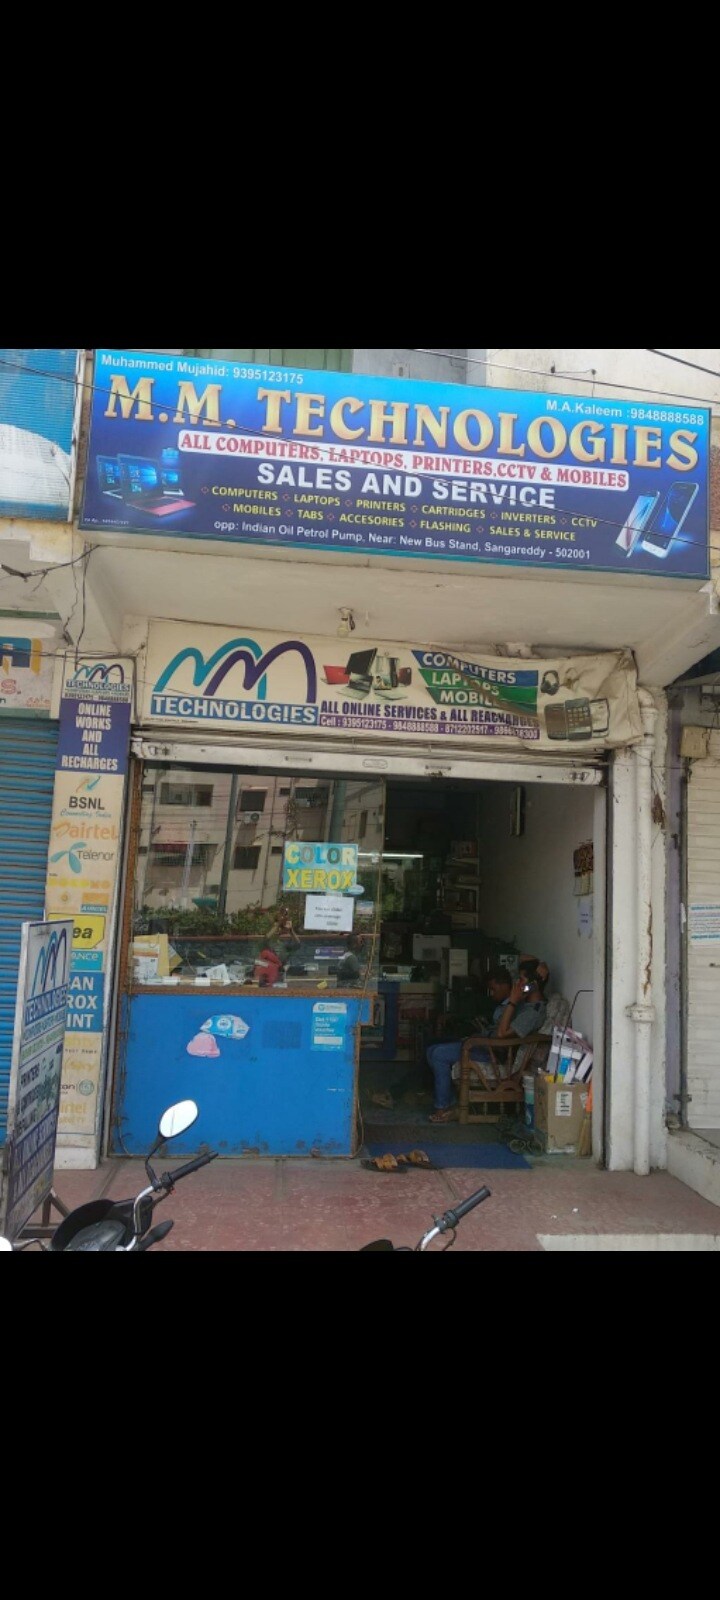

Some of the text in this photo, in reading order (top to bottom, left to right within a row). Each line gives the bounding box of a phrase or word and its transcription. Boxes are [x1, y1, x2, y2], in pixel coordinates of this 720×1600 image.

[102, 354, 304, 385] Muhammed Mujahid: 9395123175
[546, 399, 623, 418] M.A.Kaleem
[104, 374, 699, 472] M.M. TECHNOLOGIES
[181, 433, 211, 450] ALL
[540, 467, 552, 482] &
[557, 469, 627, 488] MOBILES
[257, 463, 556, 509] SALES AND SERVICE
[211, 486, 598, 529] COMPUTERS LAPTOPS PRINTERS CARTRIDGES INVERTERS CCTV
[233, 503, 576, 542] MOBILES TABS ACCESORIES FLASHING SALES & SERVICE
[214, 520, 239, 532] opp:
[242, 520, 276, 535] Indian
[278, 523, 294, 536] Oil
[296, 526, 329, 540] Petrol
[368, 533, 397, 545] Near:
[400, 536, 422, 546] New
[425, 538, 446, 549] Bus
[485, 541, 546, 557] Sangareddy
[555, 547, 591, 561] 502001
[422, 653, 517, 684] COMPUTERS
[78, 703, 112, 717] ONLINE
[152, 696, 317, 724] TECHNOLOGIES
[321, 700, 339, 713] ALL
[342, 701, 381, 717] ONLINE
[384, 705, 437, 720] SERVICES
[440, 711, 447, 721] &
[450, 709, 468, 721] ALL
[321, 716, 336, 726] Cell
[75, 717, 112, 731] WORKS
[81, 730, 103, 743] AND
[82, 743, 99, 756] ALL
[61, 755, 118, 771] RECHARGES
[69, 796, 105, 810] BSNL
[69, 822, 118, 840] airtel
[285, 844, 356, 866] COLOR
[287, 868, 355, 890] XEROX
